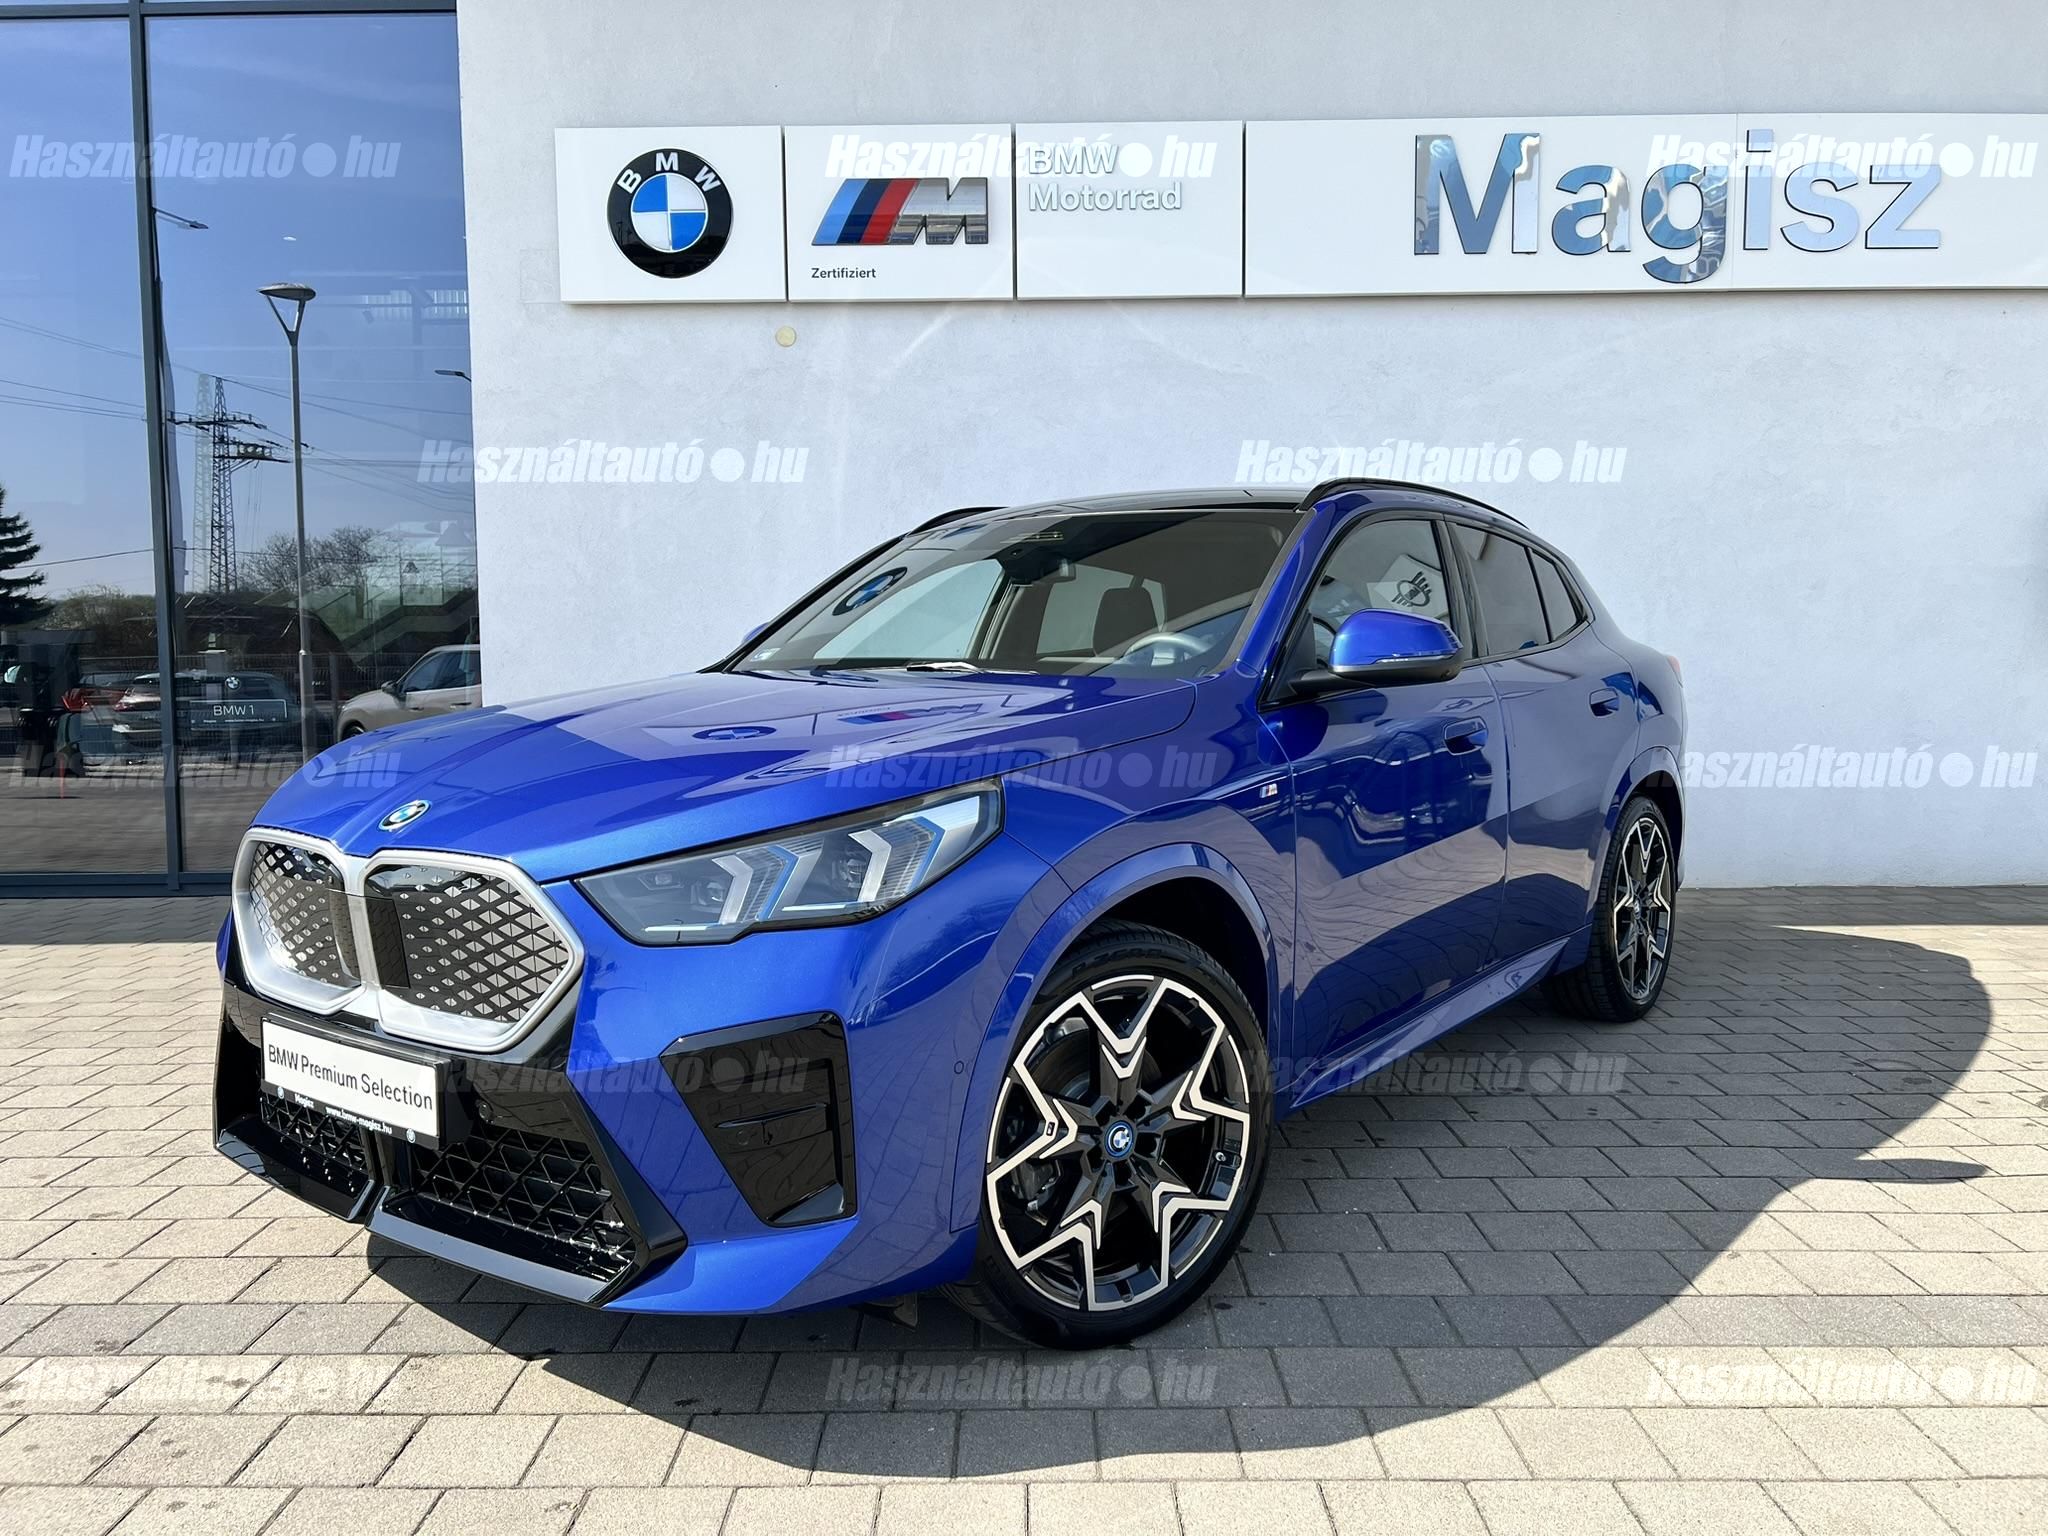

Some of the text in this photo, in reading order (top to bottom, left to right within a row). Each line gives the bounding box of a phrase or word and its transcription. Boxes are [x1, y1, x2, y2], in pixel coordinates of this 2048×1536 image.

[619, 151, 722, 191] BMW
[1028, 147, 1117, 176] BMW
[1028, 183, 1181, 213] Motorrad
[1414, 130, 1942, 283] Magisz
[812, 266, 877, 280] Zertifiziert
[213, 705, 246, 716] BMW
[268, 1044, 433, 1111] BMW Premium Selection
